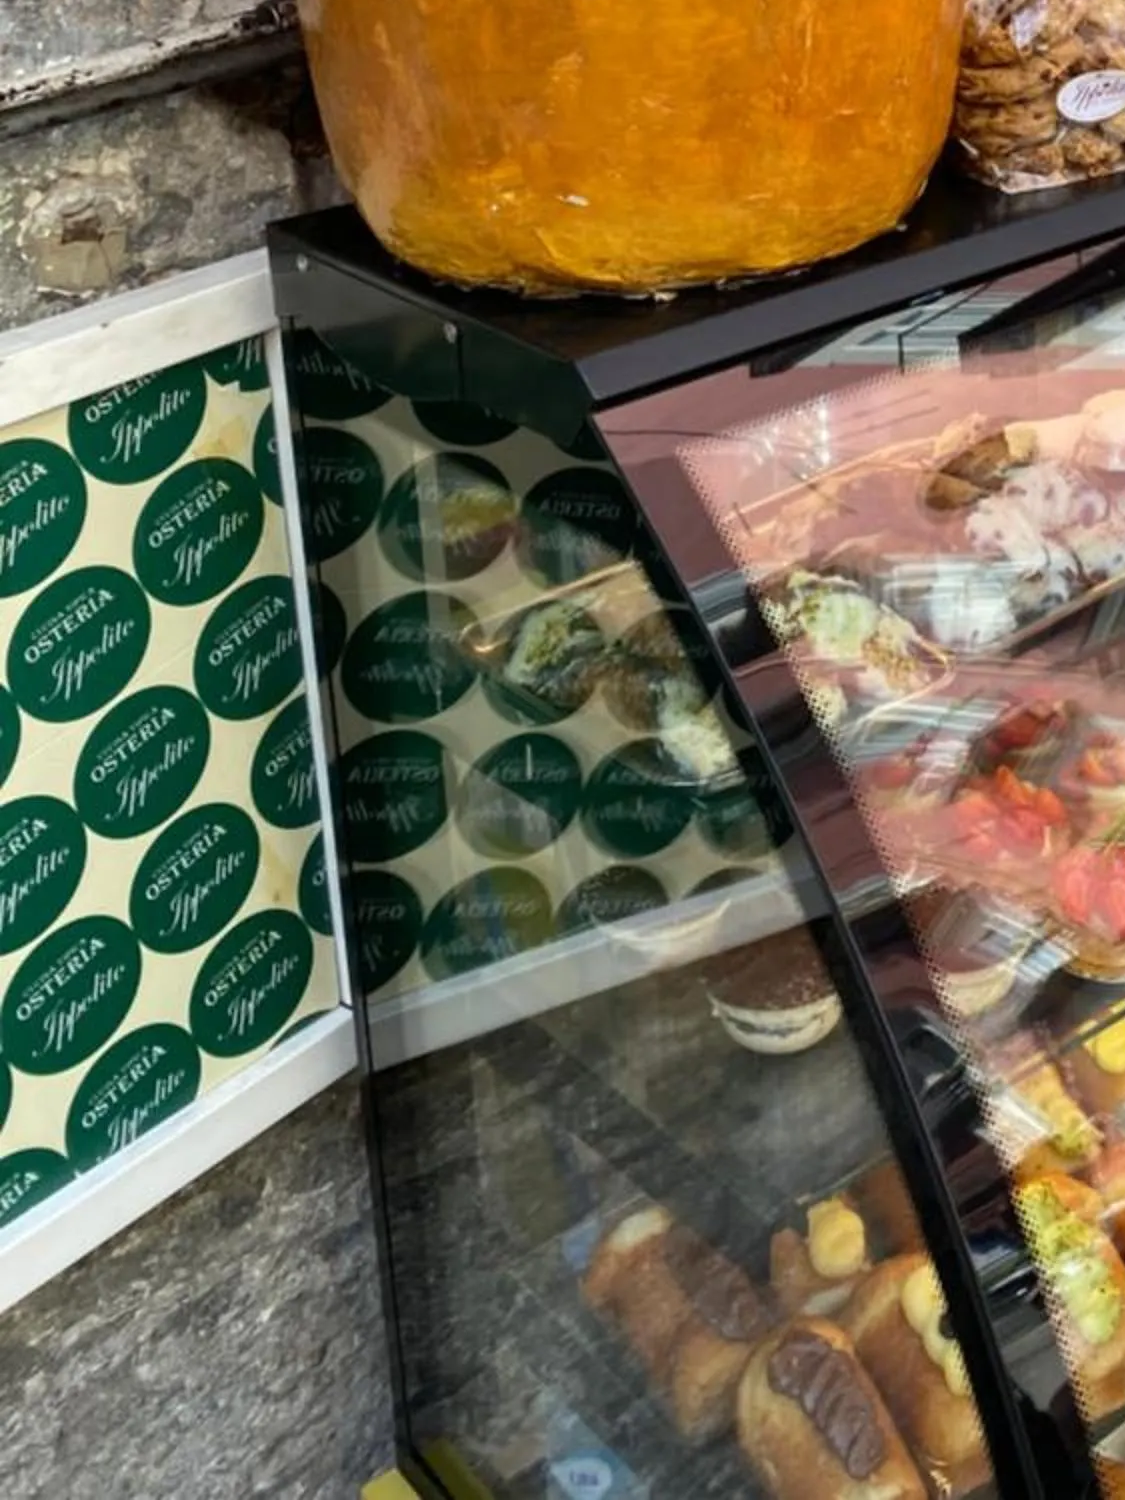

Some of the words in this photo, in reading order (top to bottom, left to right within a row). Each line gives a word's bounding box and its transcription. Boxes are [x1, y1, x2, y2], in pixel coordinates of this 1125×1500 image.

[148, 479, 232, 549] OSTERIA
[23, 588, 115, 664] OSTERIA
[208, 596, 287, 668] OSTERIA
[89, 706, 176, 784] OSTERIA
[145, 823, 228, 901] OSTERIA
[15, 937, 106, 1022] OSTERIA
[203, 930, 283, 1007] OSTERIA
[81, 1044, 168, 1129] OSTERIA
